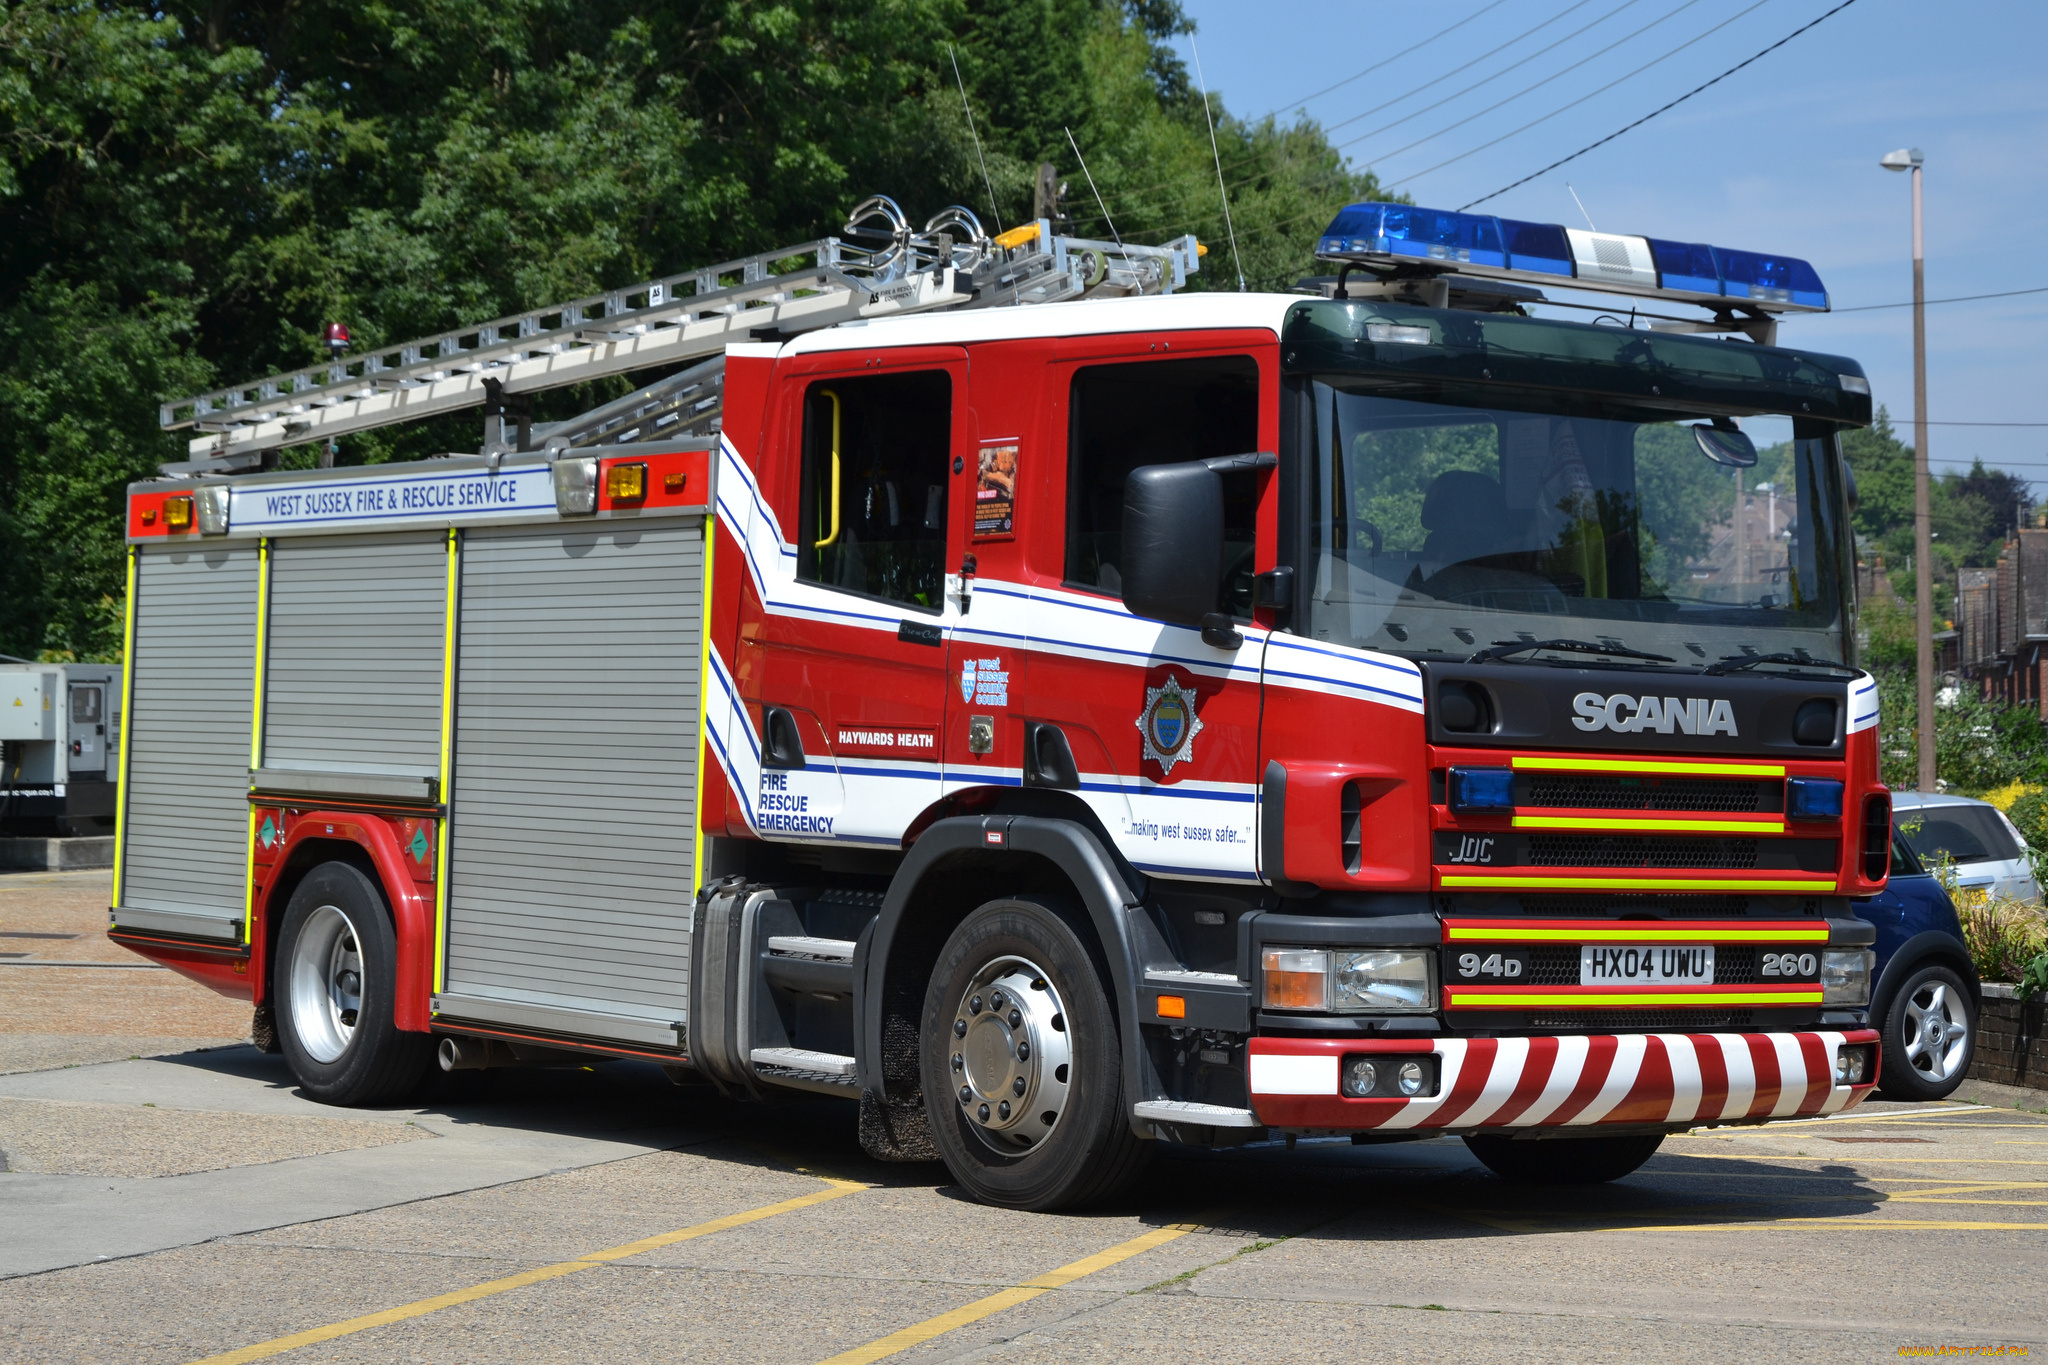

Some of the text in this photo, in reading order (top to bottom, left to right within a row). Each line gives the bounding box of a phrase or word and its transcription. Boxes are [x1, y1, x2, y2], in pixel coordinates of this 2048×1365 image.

[266, 480, 516, 516] WEST SUSSEX FIRE & RESCUE SERVICE
[978, 657, 1000, 671] west
[977, 671, 1009, 683] sussex
[976, 681, 1007, 695] county
[976, 692, 1008, 706] council
[1571, 691, 1739, 737] SCANIA
[838, 730, 934, 748] HAYWARDS HEATH
[761, 773, 788, 791] FIRE
[760, 793, 808, 813] RESCUE
[758, 813, 834, 834] EMERGENCY
[1161, 822, 1181, 839] west
[1183, 825, 1213, 842] sussex
[1458, 953, 1523, 978] 94D
[1591, 948, 1706, 978] HX04 UWU
[1762, 953, 1817, 977] 260
